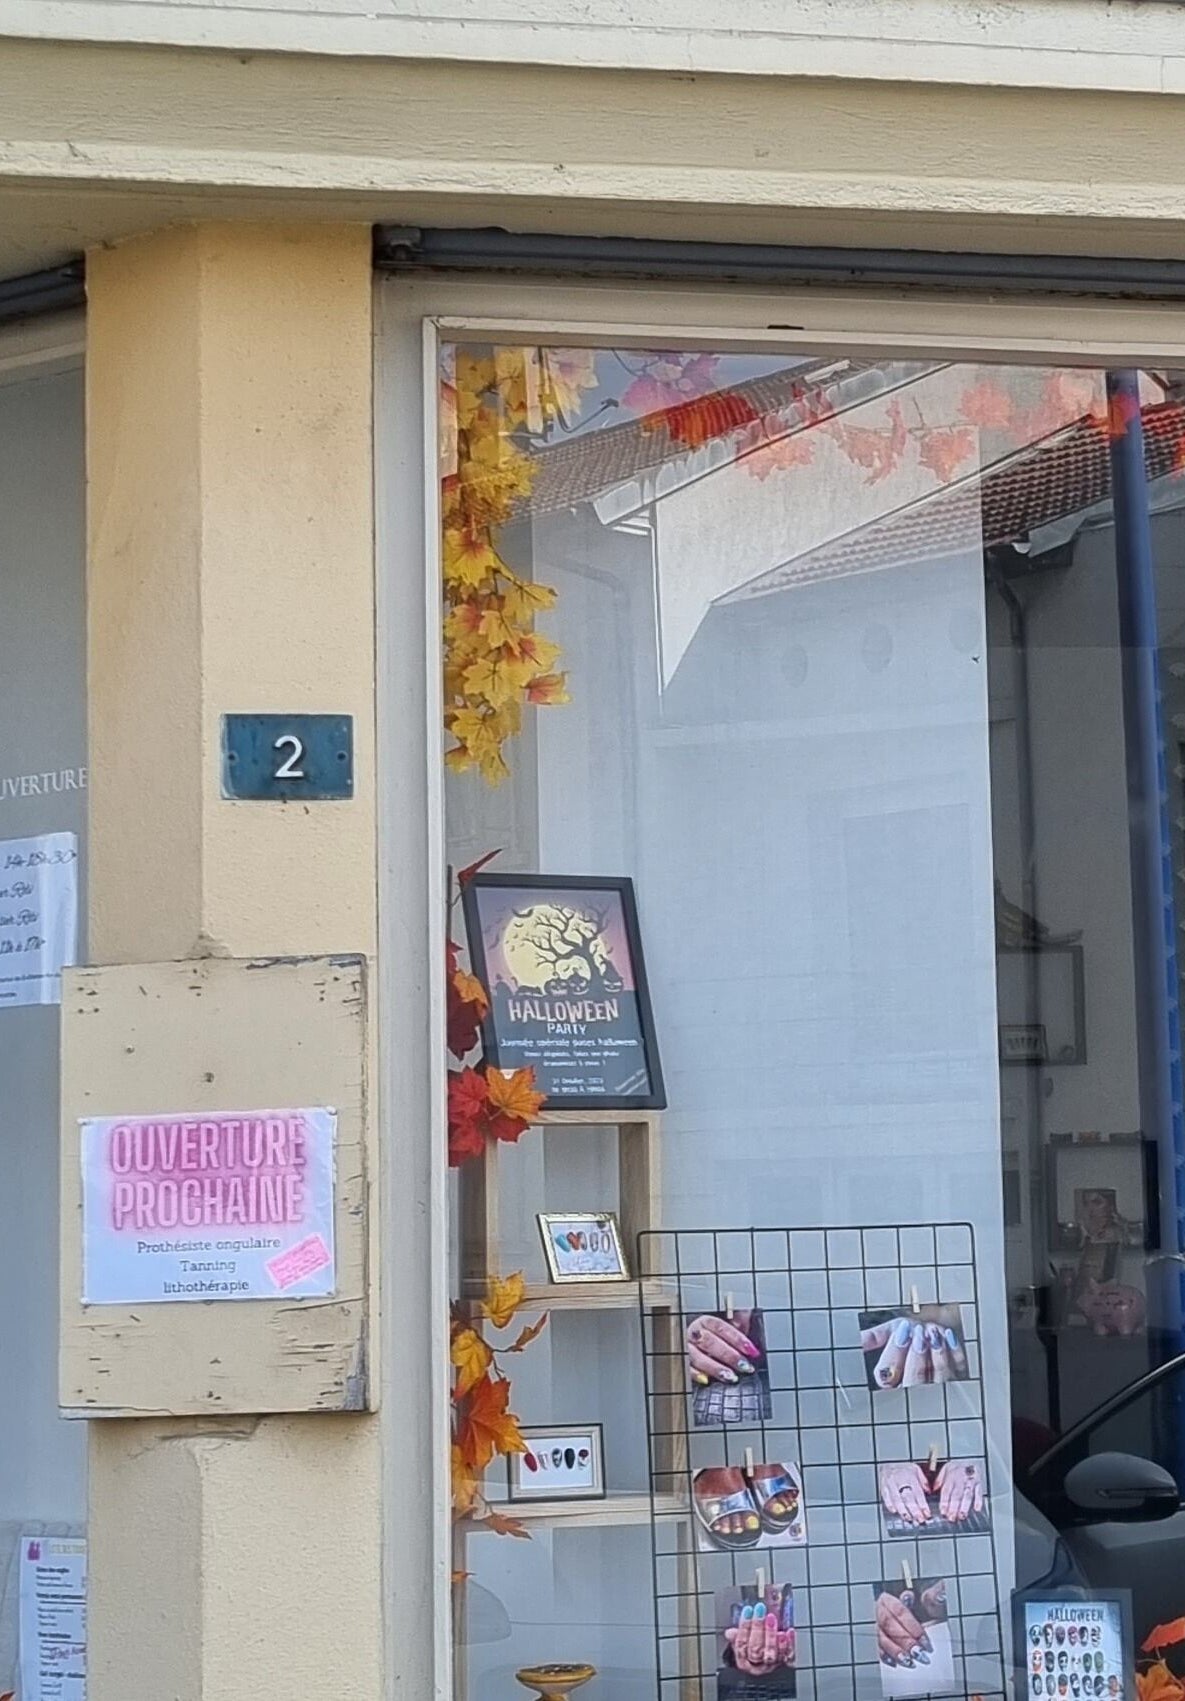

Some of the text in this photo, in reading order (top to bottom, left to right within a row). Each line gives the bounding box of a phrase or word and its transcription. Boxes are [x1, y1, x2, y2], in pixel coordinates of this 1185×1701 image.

[274, 736, 304, 778] 2
[508, 998, 619, 1023] HALLOWEEN
[546, 1023, 587, 1035] PARTY
[111, 1117, 307, 1173] OUVERTURE
[113, 1172, 304, 1230] PROCHAINE
[137, 1237, 280, 1254] Prothésiste ongulaire
[180, 1260, 236, 1273] Tanning
[163, 1280, 249, 1294] lithothérapie
[1047, 1607, 1105, 1621] HALLOWEEN
